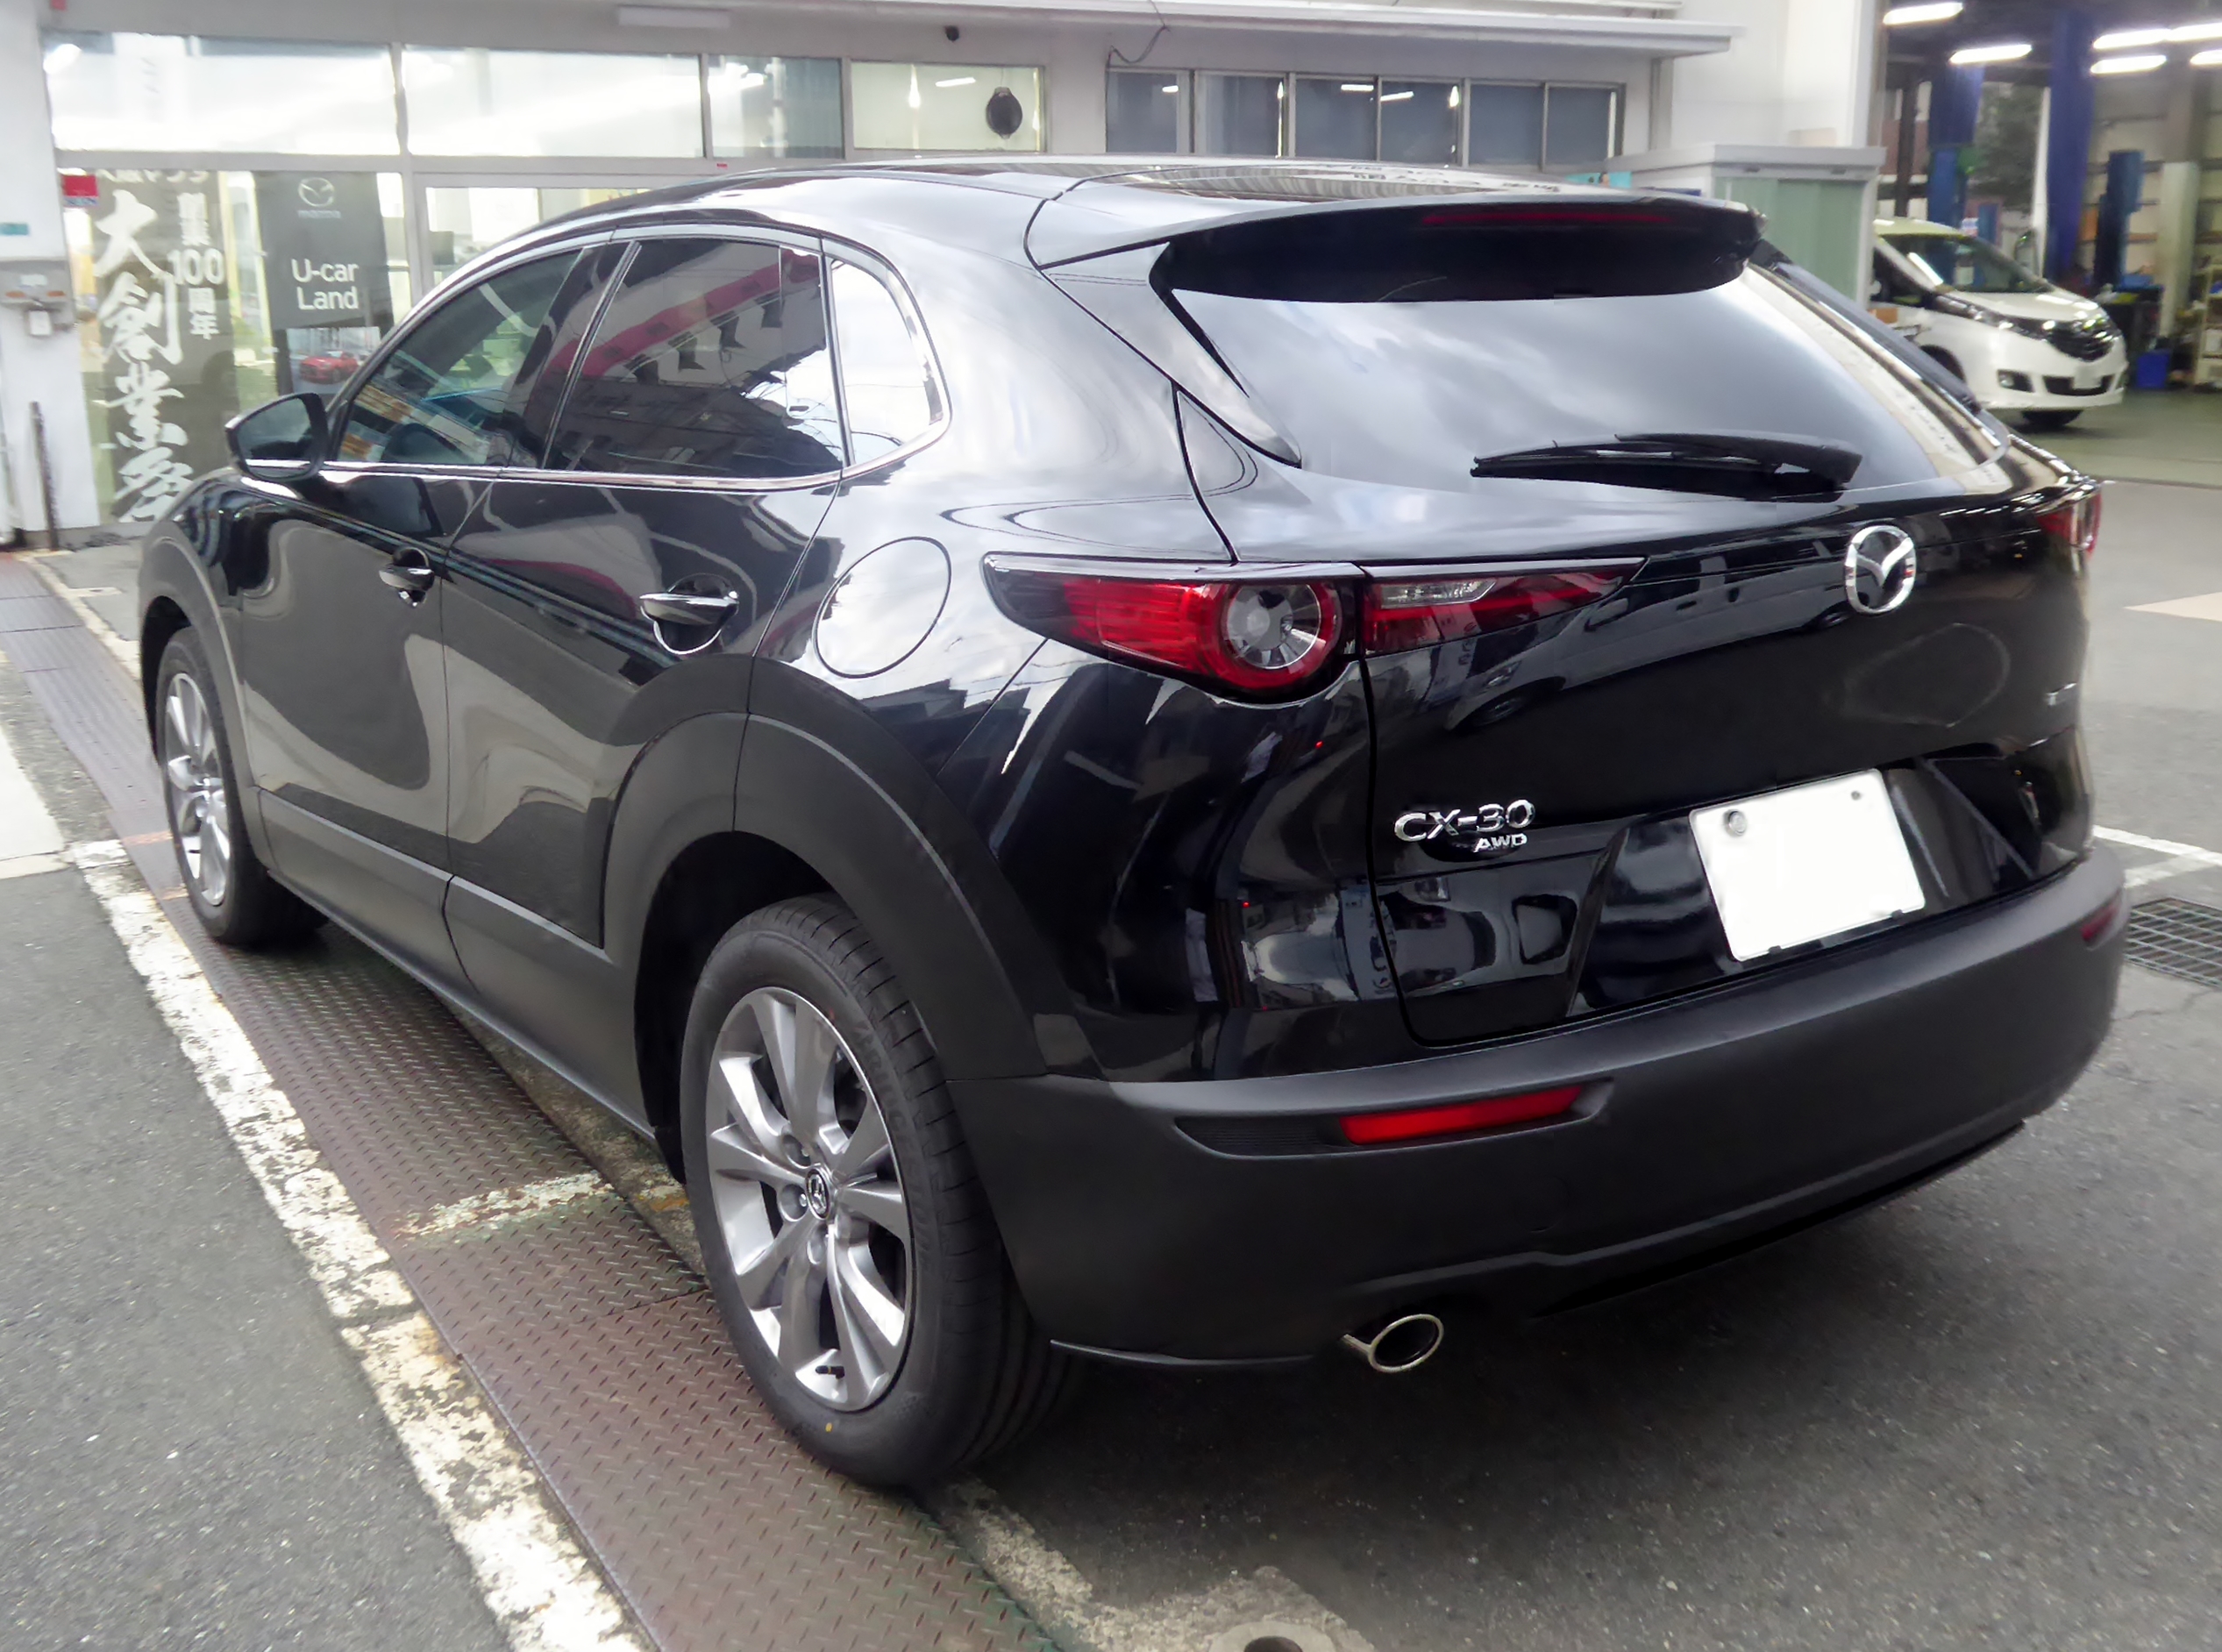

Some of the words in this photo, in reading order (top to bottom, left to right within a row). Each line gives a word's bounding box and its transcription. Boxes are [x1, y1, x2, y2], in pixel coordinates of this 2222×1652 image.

[291, 258, 359, 282] U-car
[296, 286, 359, 310] Land
[1394, 799, 1535, 842] CX-30
[1473, 833, 1528, 853] AWD
